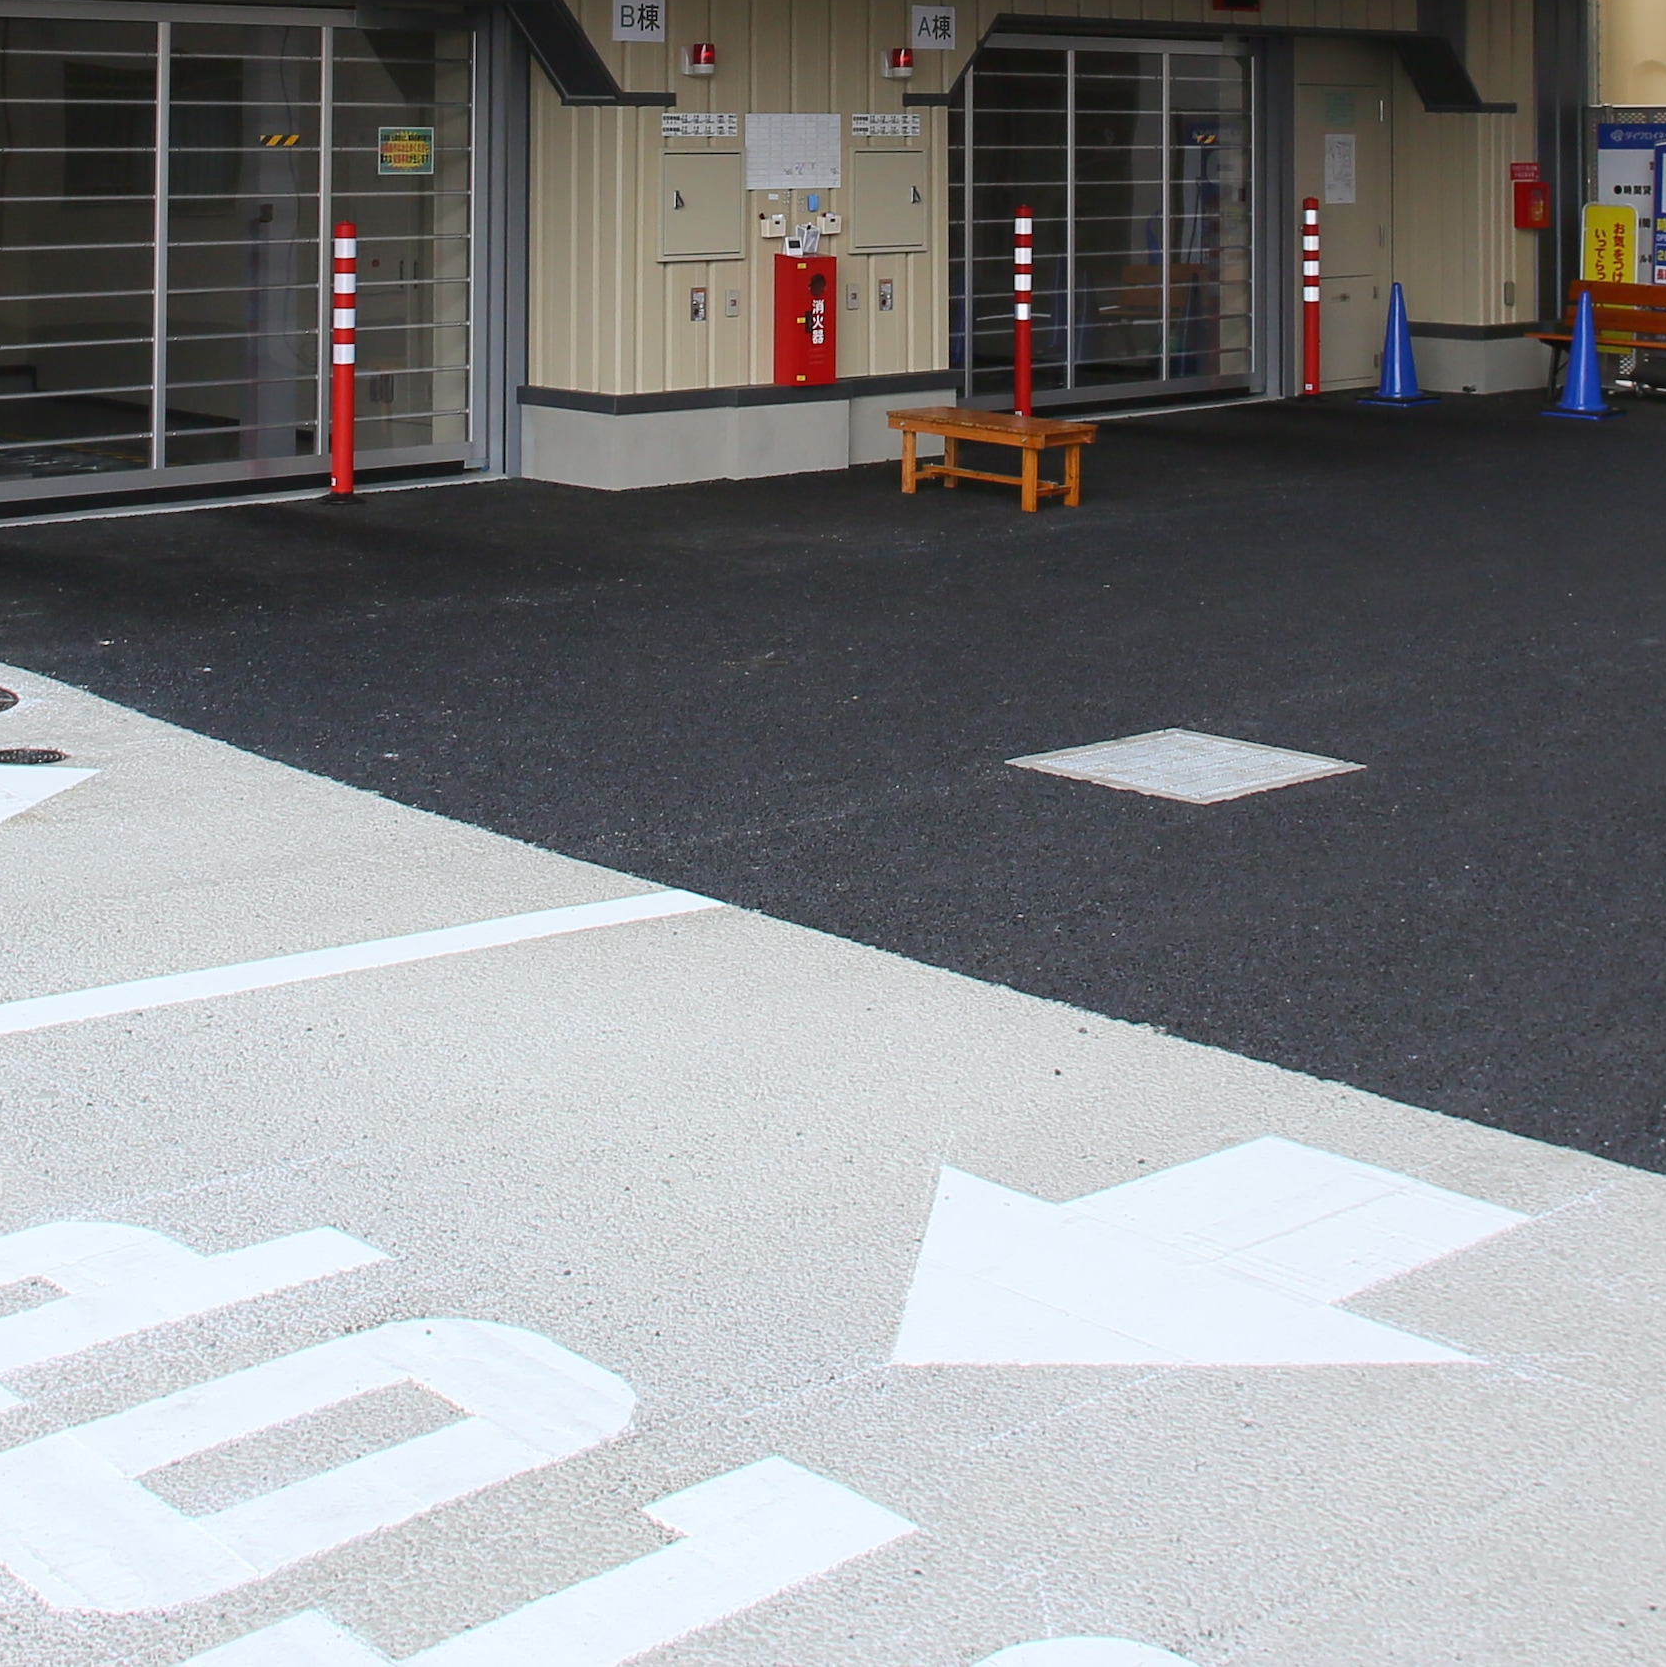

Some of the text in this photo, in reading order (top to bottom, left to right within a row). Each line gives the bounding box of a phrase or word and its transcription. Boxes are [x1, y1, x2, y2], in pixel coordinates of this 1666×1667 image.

[620, 2, 661, 32] B棟
[917, 14, 952, 41] A棟
[811, 299, 824, 345] 消火器
